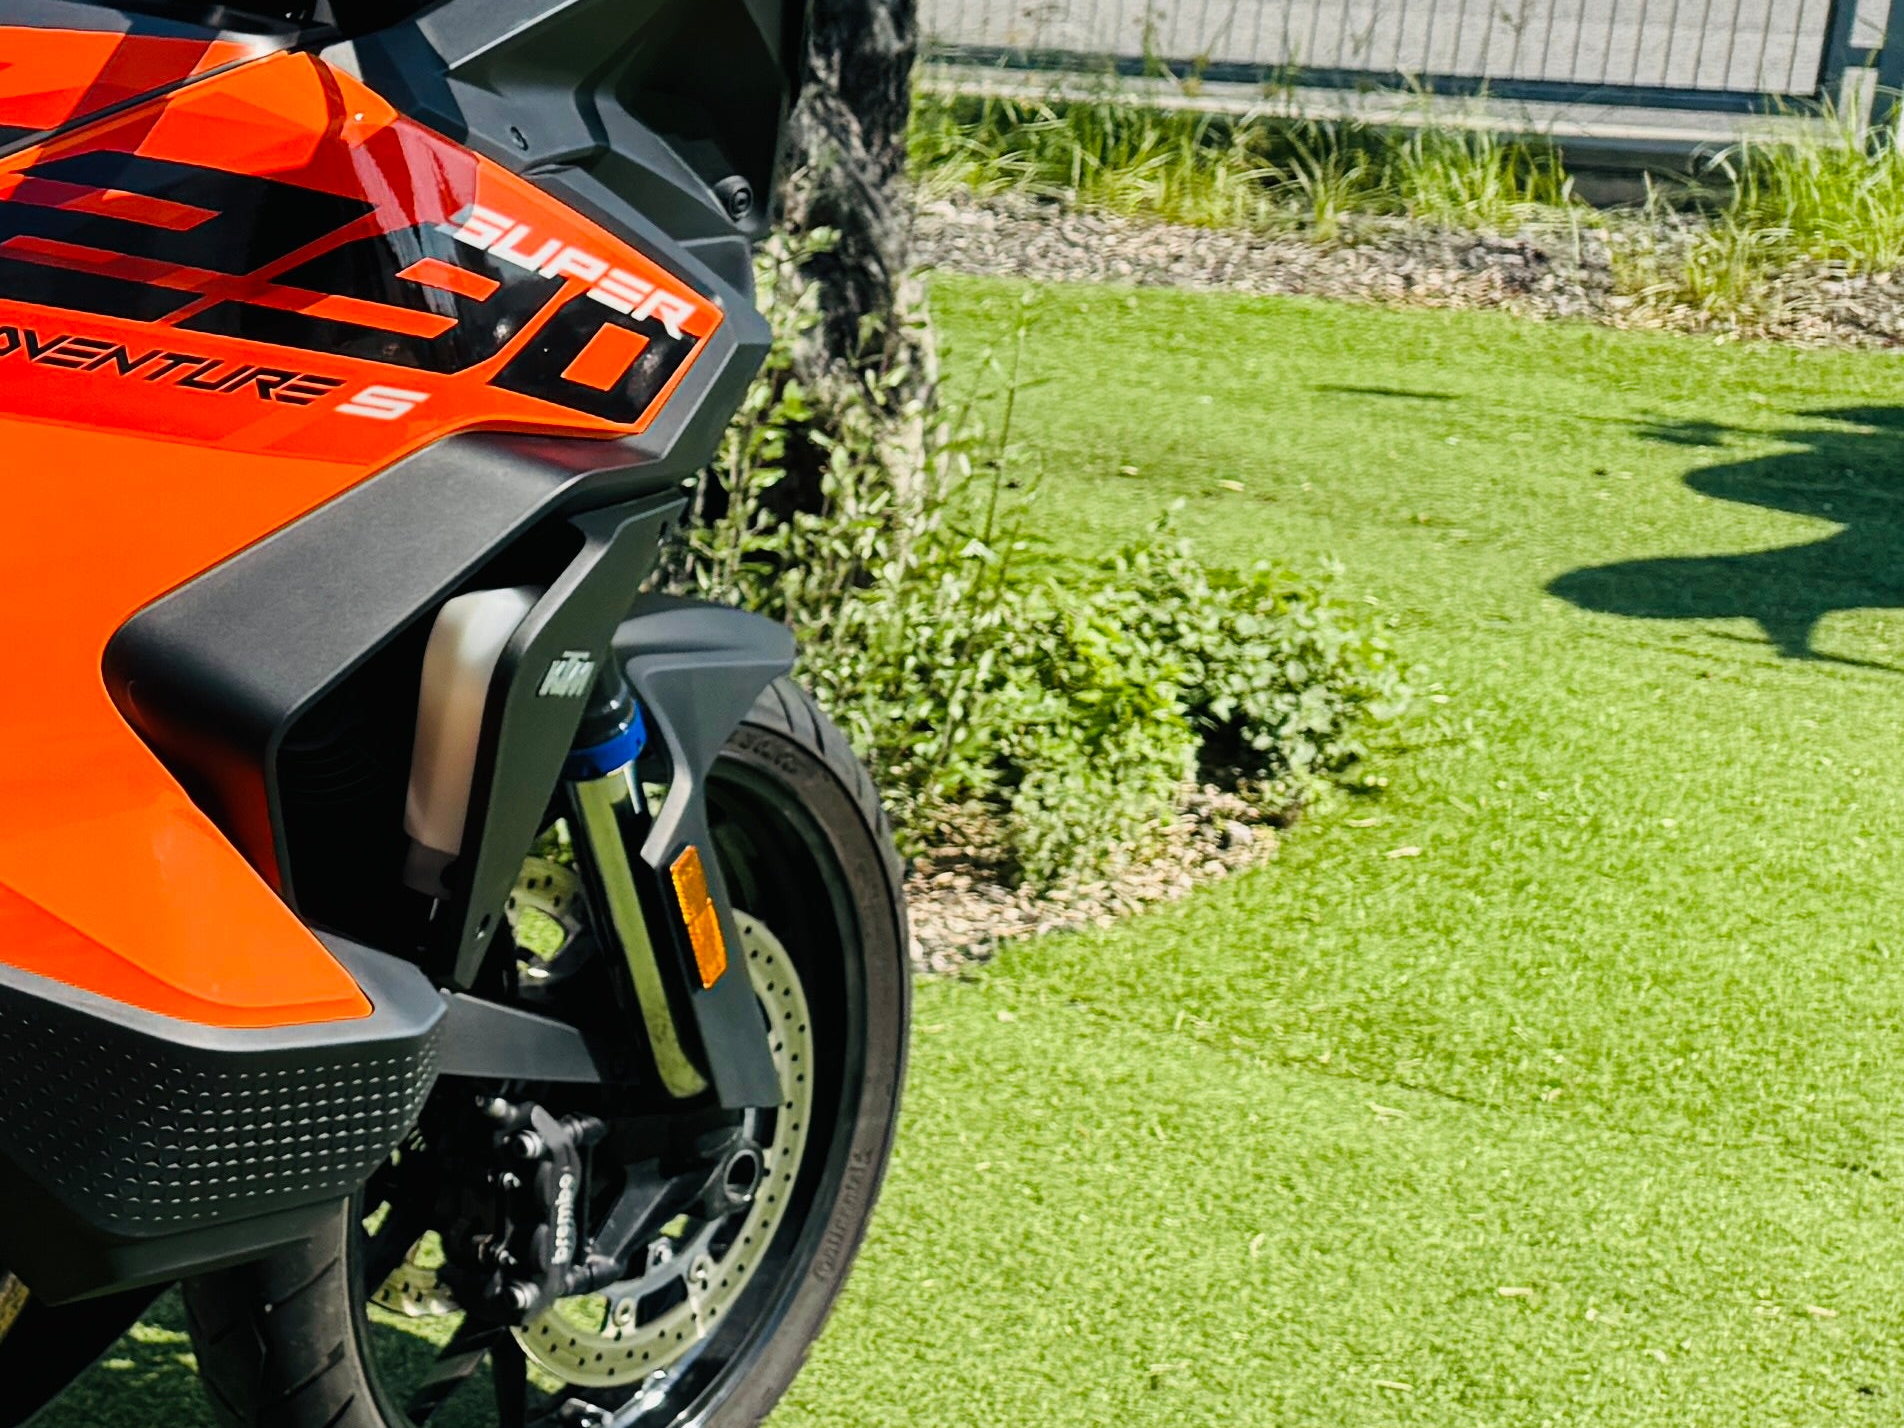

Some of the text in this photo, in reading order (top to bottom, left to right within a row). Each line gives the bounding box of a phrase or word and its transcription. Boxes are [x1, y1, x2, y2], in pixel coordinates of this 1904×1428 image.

[435, 205, 697, 340] SUPER
[334, 385, 431, 420] S
[538, 651, 595, 697] KTM
